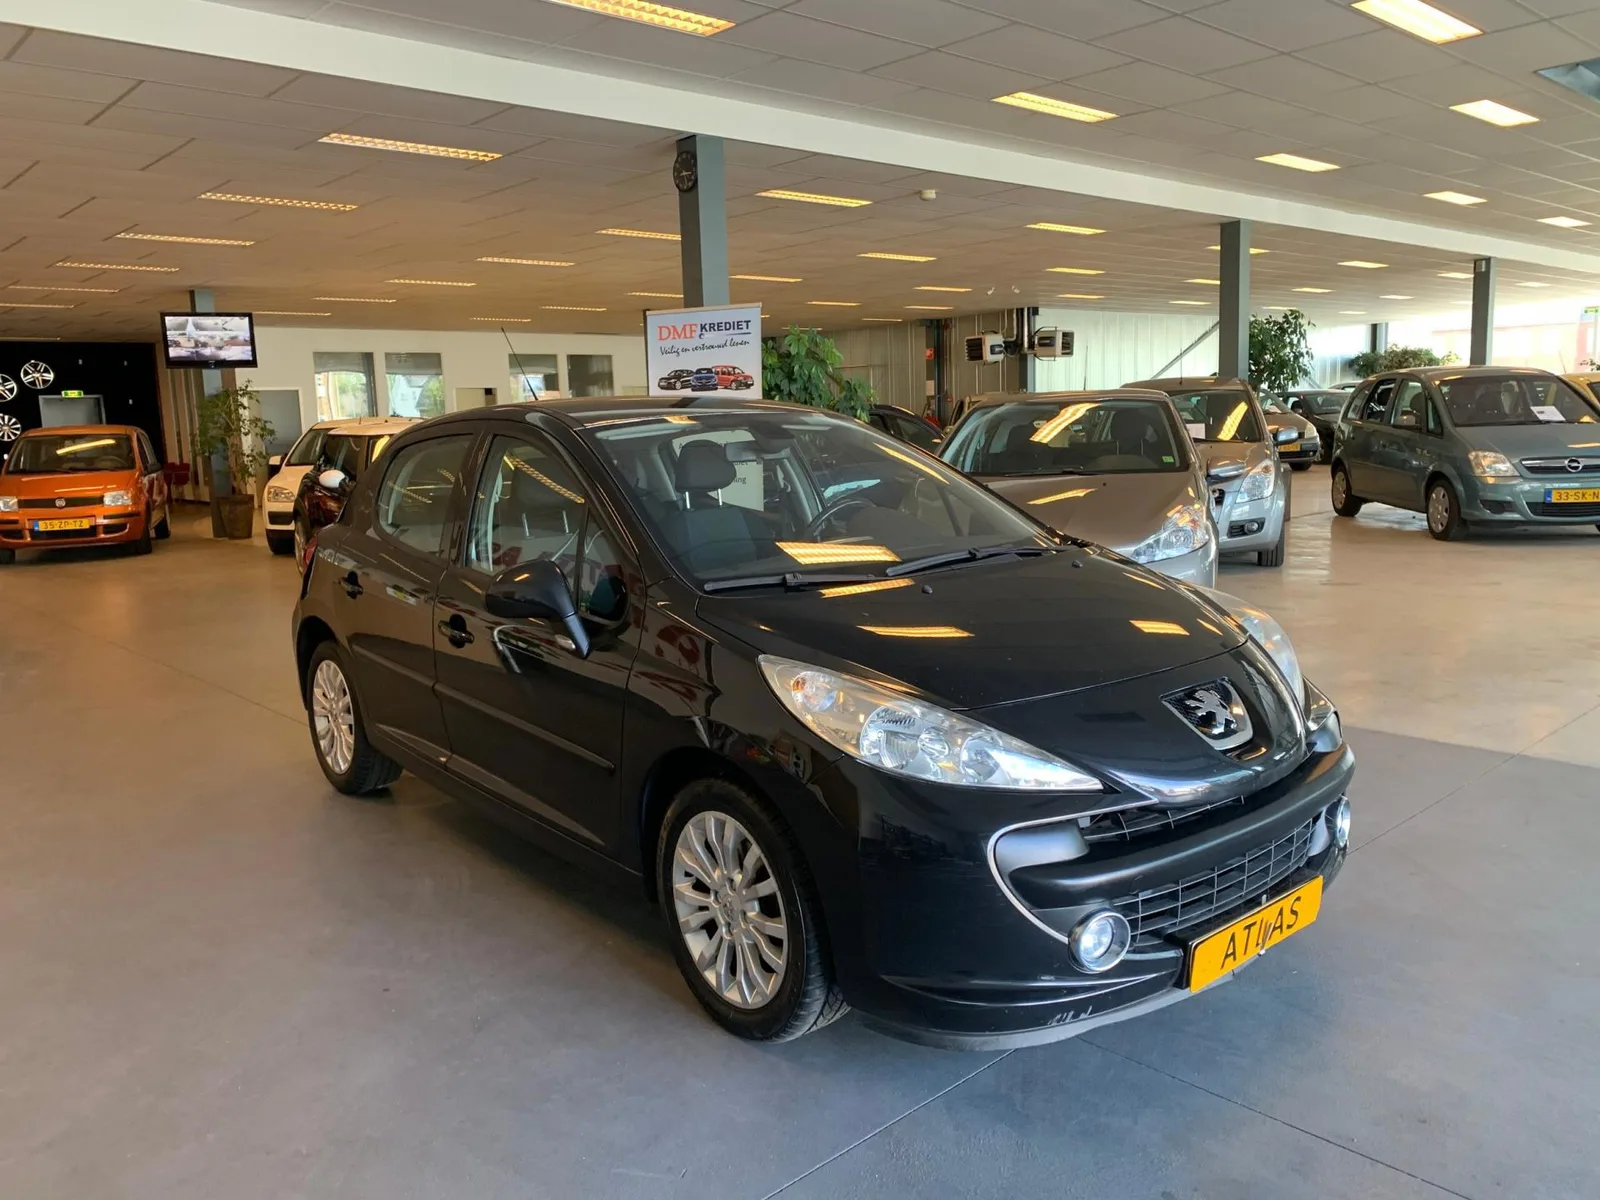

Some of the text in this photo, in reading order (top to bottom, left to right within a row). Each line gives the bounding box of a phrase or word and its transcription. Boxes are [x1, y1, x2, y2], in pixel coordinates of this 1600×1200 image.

[657, 320, 751, 341] DMF KREDIET
[660, 345, 680, 357] Veilig
[729, 338, 750, 347] lenen
[1220, 896, 1302, 971] ATLAS
